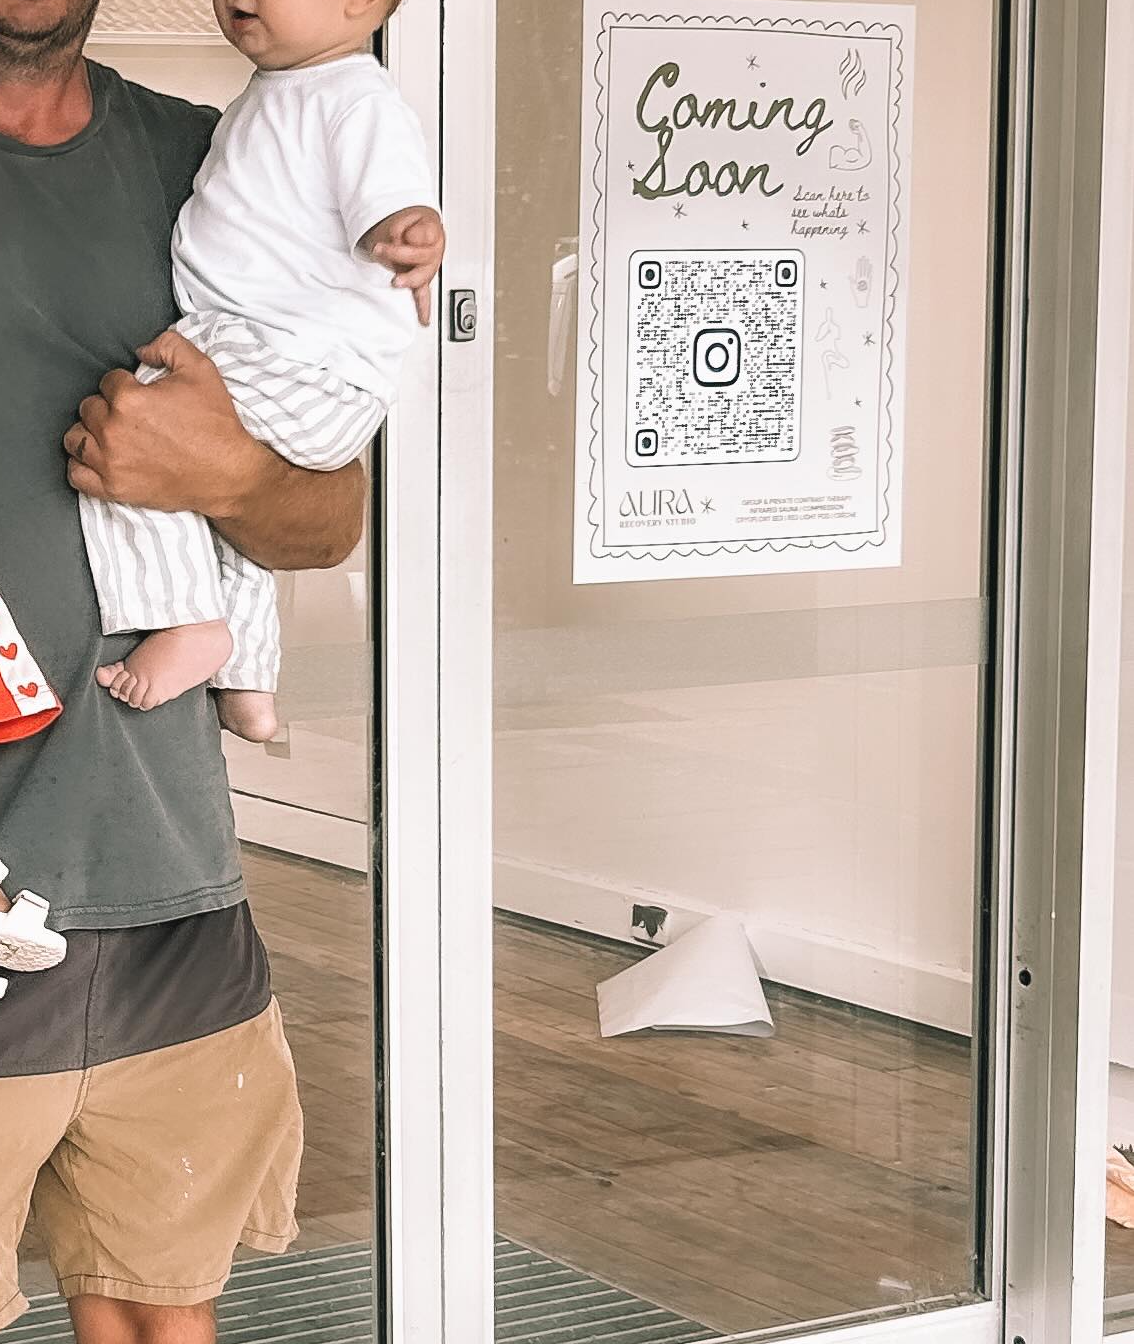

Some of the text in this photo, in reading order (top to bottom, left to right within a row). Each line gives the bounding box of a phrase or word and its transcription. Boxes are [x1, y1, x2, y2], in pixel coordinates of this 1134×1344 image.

[636, 62, 833, 156] Coming
[633, 126, 784, 200] Soon
[793, 185, 870, 202] Scan here to
[791, 203, 849, 218] see whats
[791, 219, 849, 240] happening
[619, 488, 694, 517] AURA
